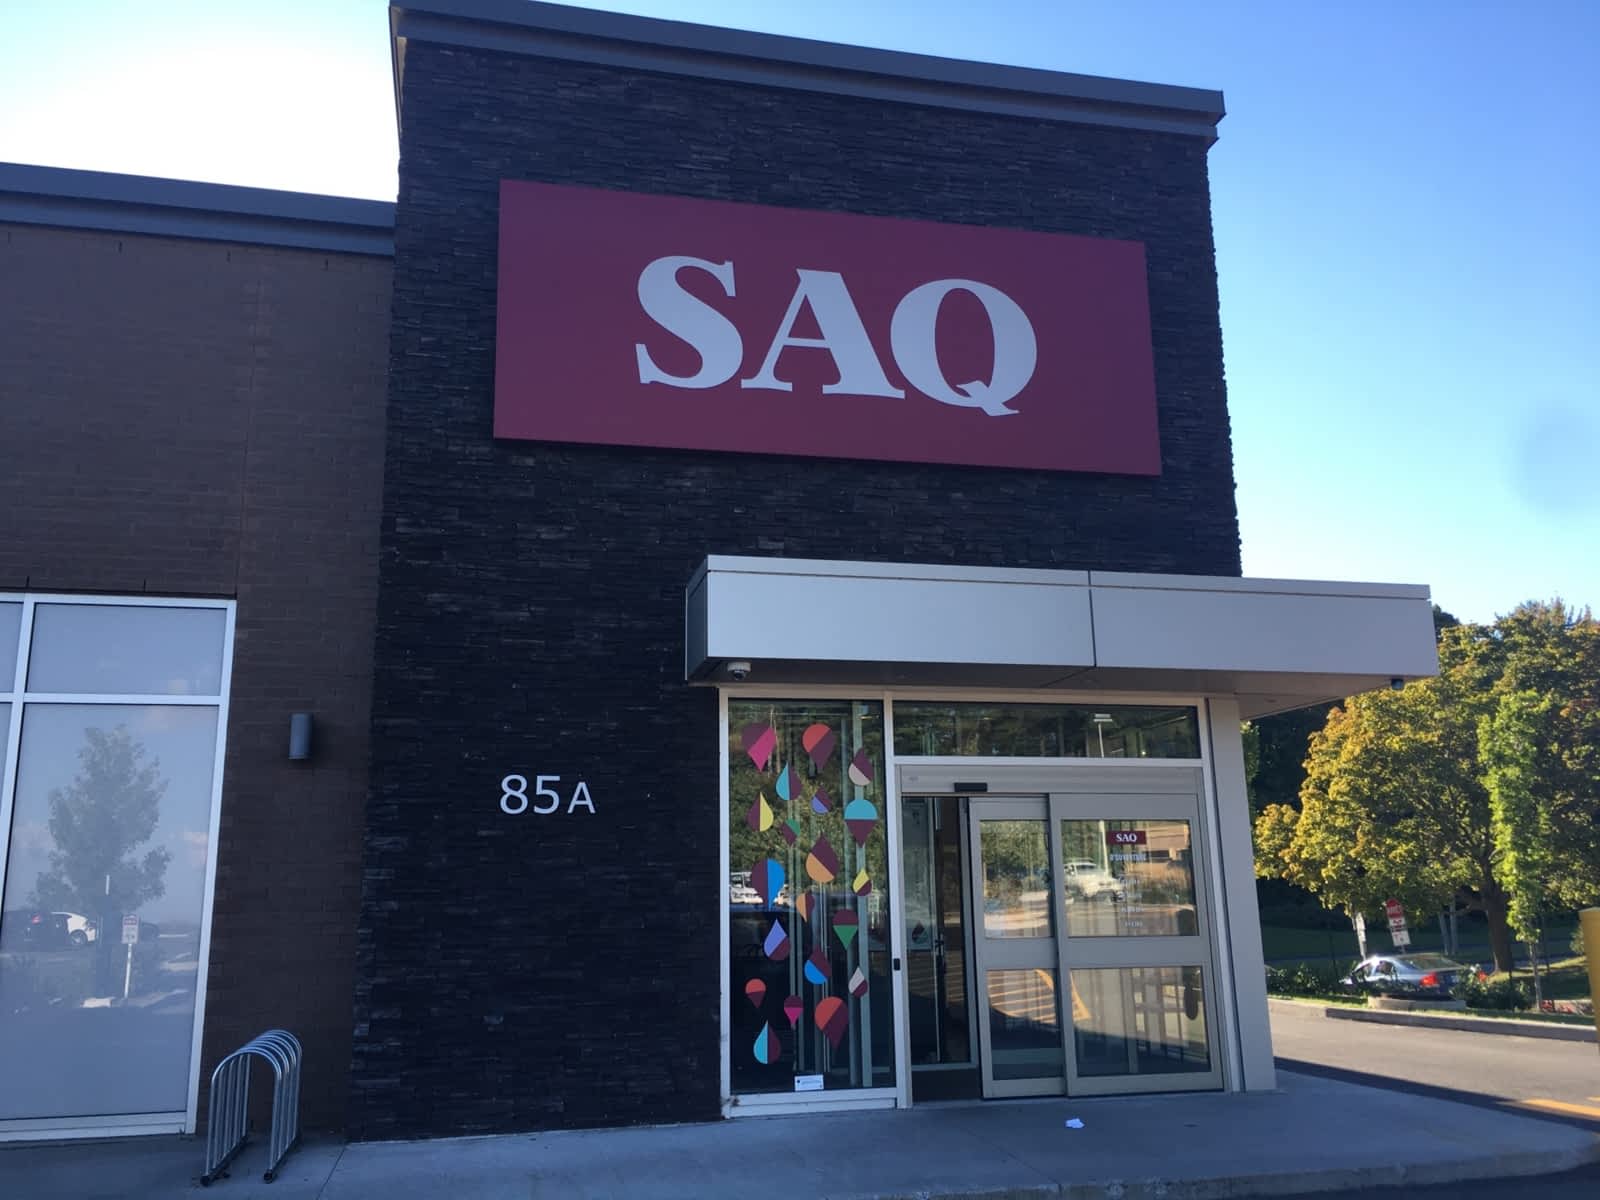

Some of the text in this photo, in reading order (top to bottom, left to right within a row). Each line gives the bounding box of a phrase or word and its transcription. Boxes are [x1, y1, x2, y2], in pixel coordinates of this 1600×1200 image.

[635, 255, 1038, 417] SAQ
[500, 774, 596, 815] 85A
[1115, 832, 1138, 843] SAQ
